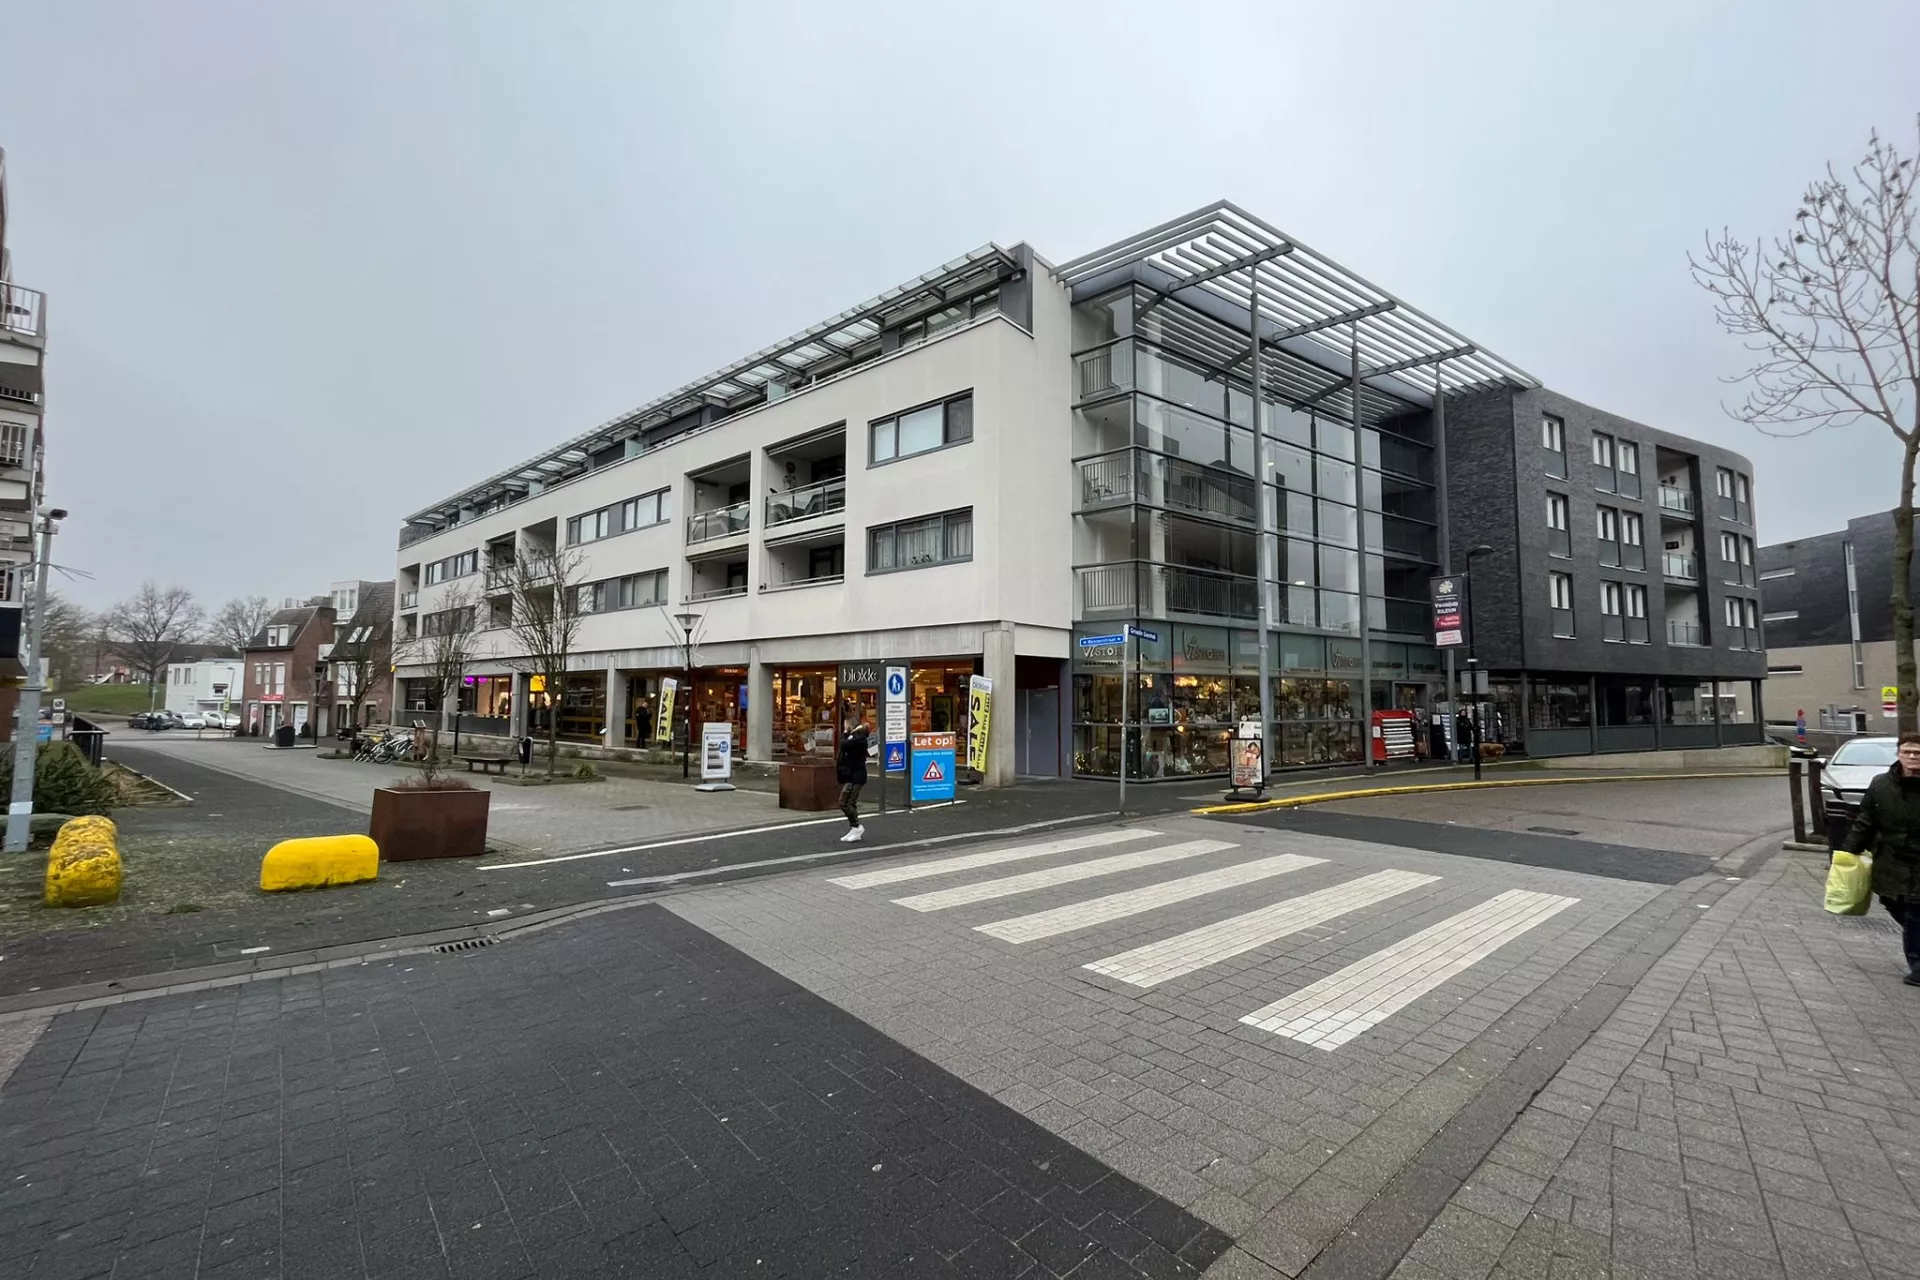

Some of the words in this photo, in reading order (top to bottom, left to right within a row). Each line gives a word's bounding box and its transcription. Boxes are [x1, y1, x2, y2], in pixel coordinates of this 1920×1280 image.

[658, 692, 668, 736] SALE
[971, 695, 981, 761] SALE
[914, 736, 933, 746] Let
[935, 736, 953, 746] op!
